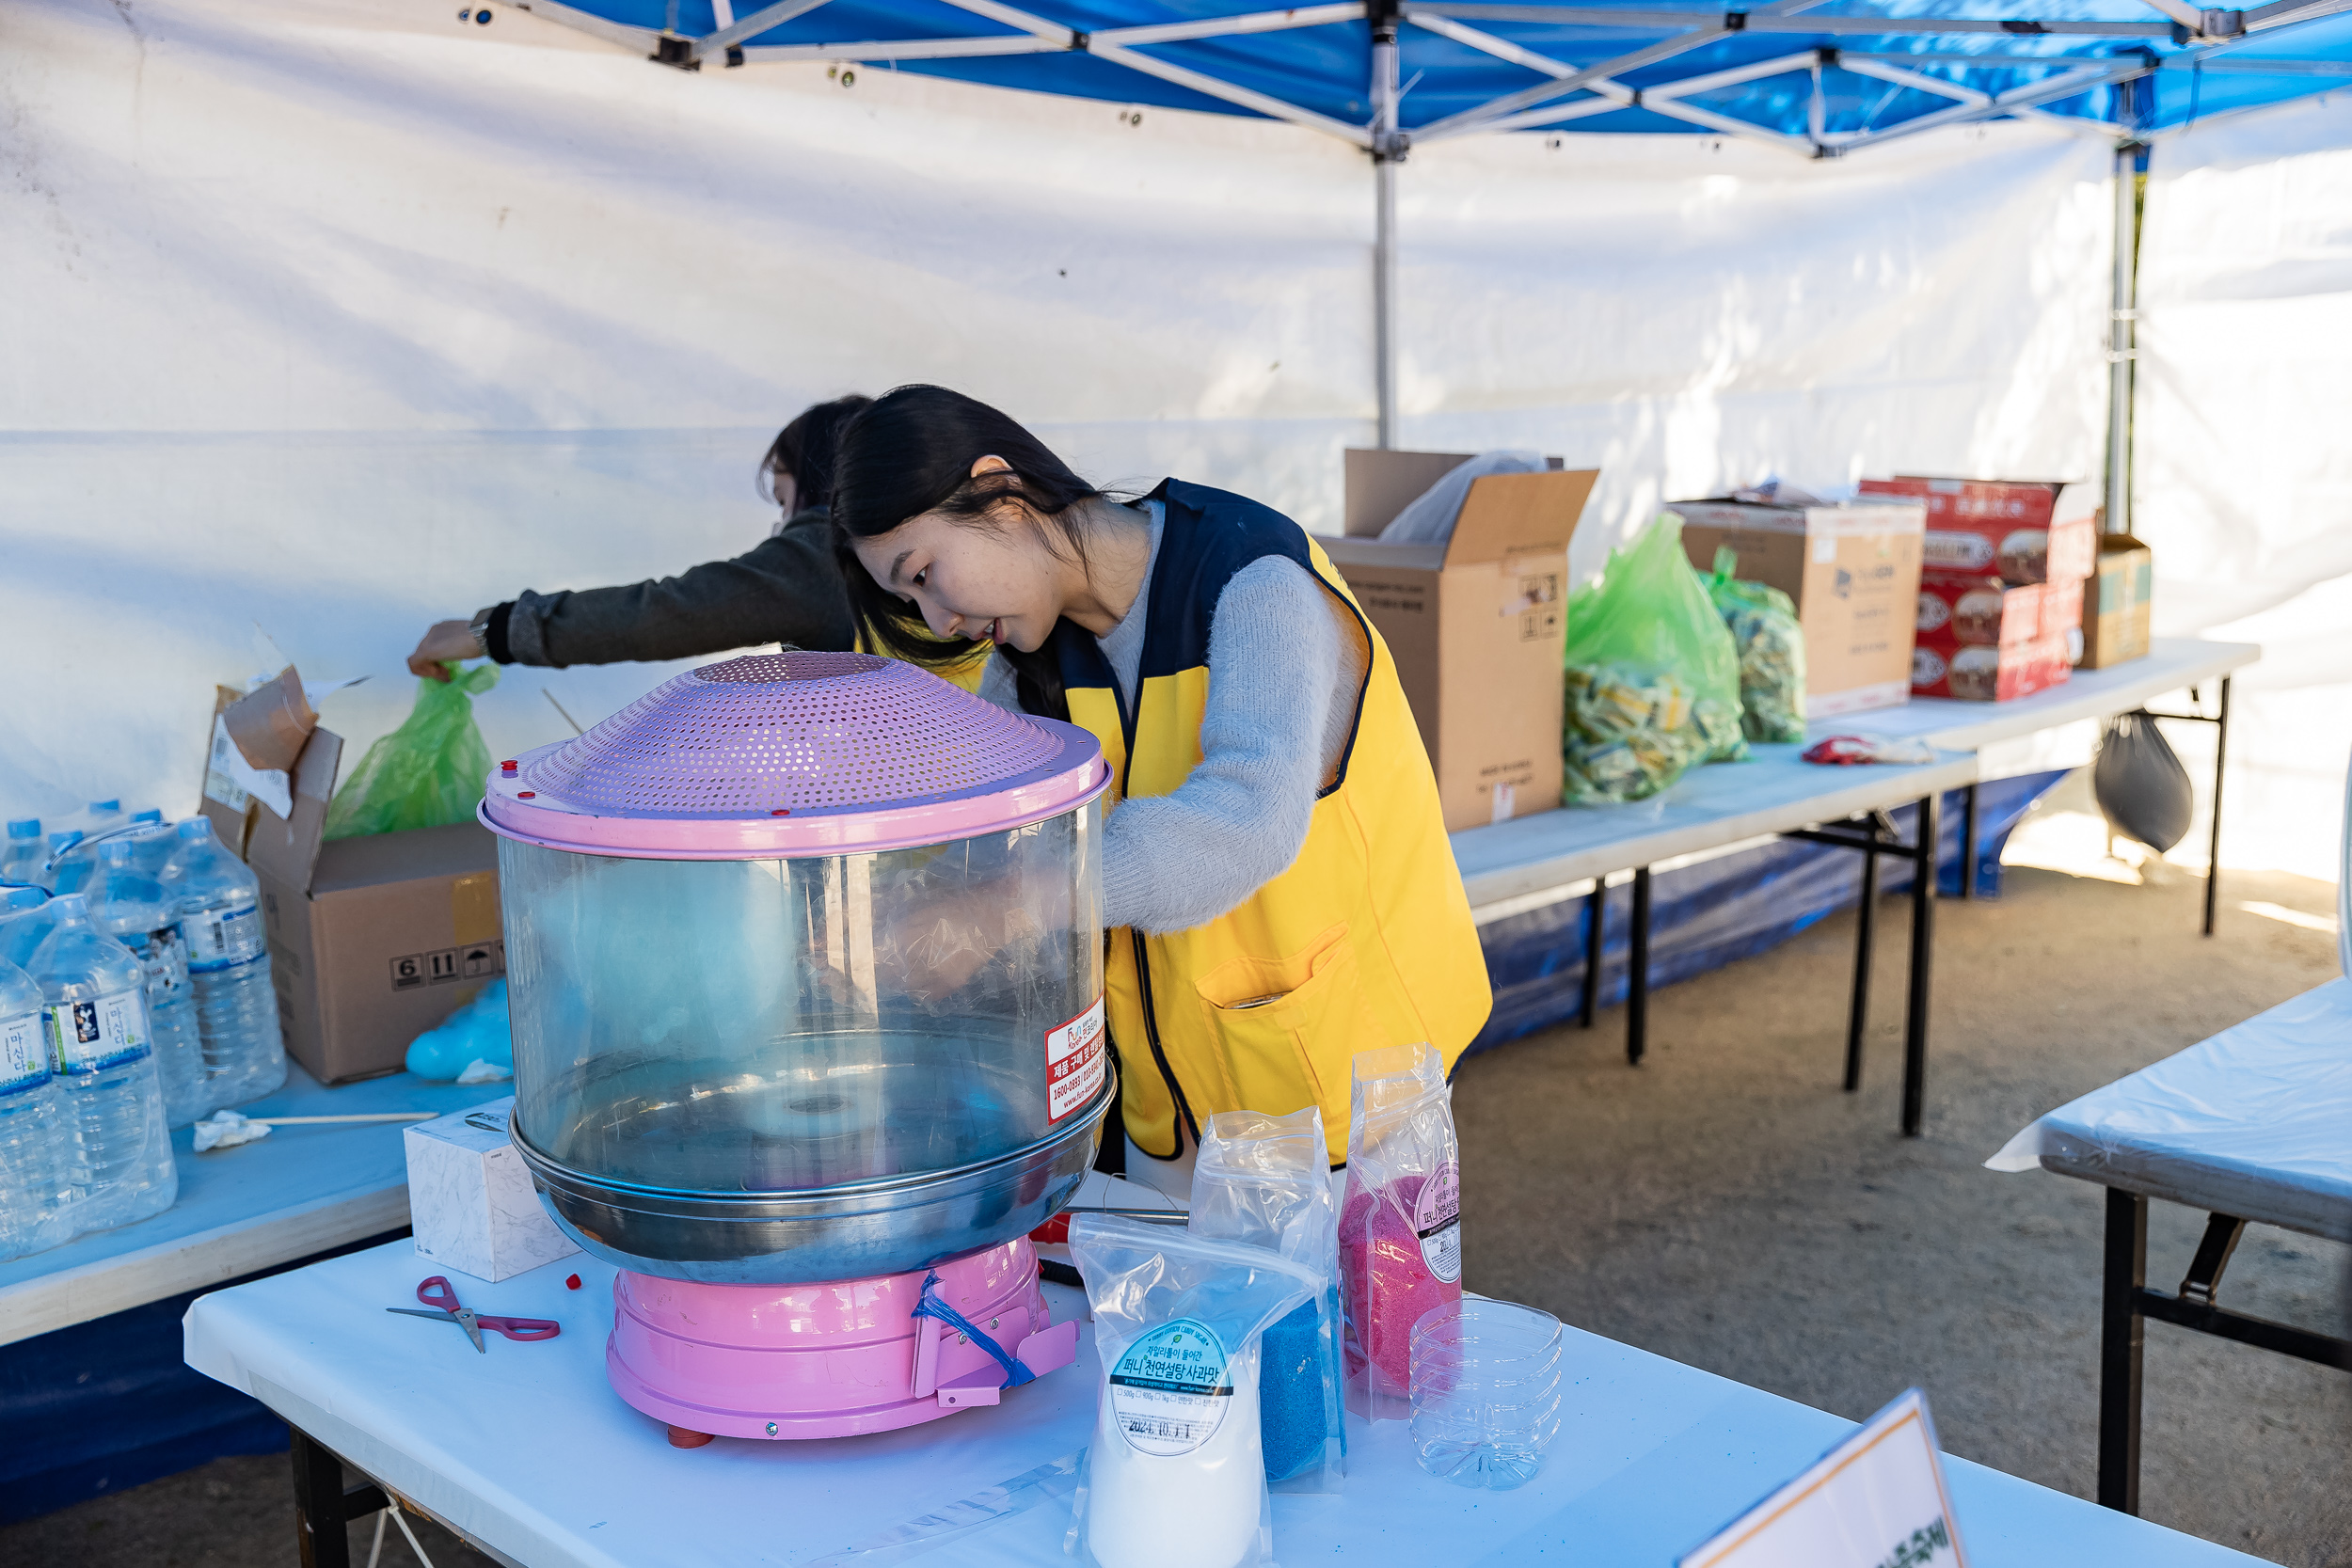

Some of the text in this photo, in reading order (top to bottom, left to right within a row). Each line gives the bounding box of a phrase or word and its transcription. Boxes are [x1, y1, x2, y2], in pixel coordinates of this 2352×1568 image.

[110, 1006, 125, 1046] 마신다
[10, 1032, 26, 1072] 마신다
[1054, 1061, 1069, 1078] 제품
[1070, 1050, 1084, 1070] 구매
[1084, 1044, 1089, 1061] 및
[1423, 1211, 1438, 1225] 퍼니
[1146, 1345, 1202, 1362] 자일리톨이 들어간
[1123, 1358, 1144, 1375] 퍼니
[1144, 1359, 1186, 1380] 천연설탕
[1186, 1365, 1220, 1385] 사과맛
[1122, 1388, 1135, 1399] 500g
[1142, 1391, 1153, 1402] 900g
